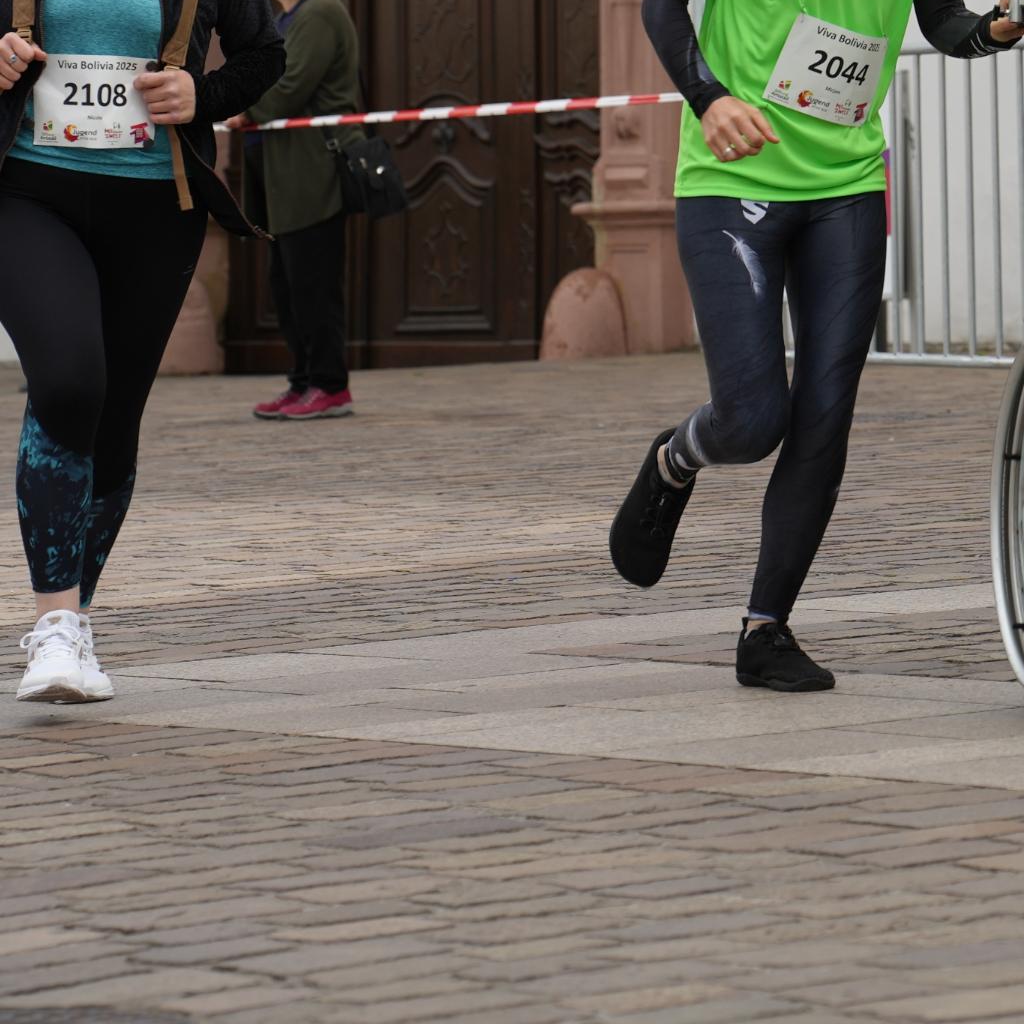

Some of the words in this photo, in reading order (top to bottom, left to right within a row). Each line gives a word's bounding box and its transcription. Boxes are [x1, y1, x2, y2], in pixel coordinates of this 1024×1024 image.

[817, 25, 837, 40] Viva
[839, 34, 868, 51] Bolivia
[57, 59, 78, 70] Viva
[80, 60, 114, 71] Bolivia
[116, 61, 138, 71] 2025
[808, 49, 870, 86] 2044
[63, 82, 127, 107] 2108
